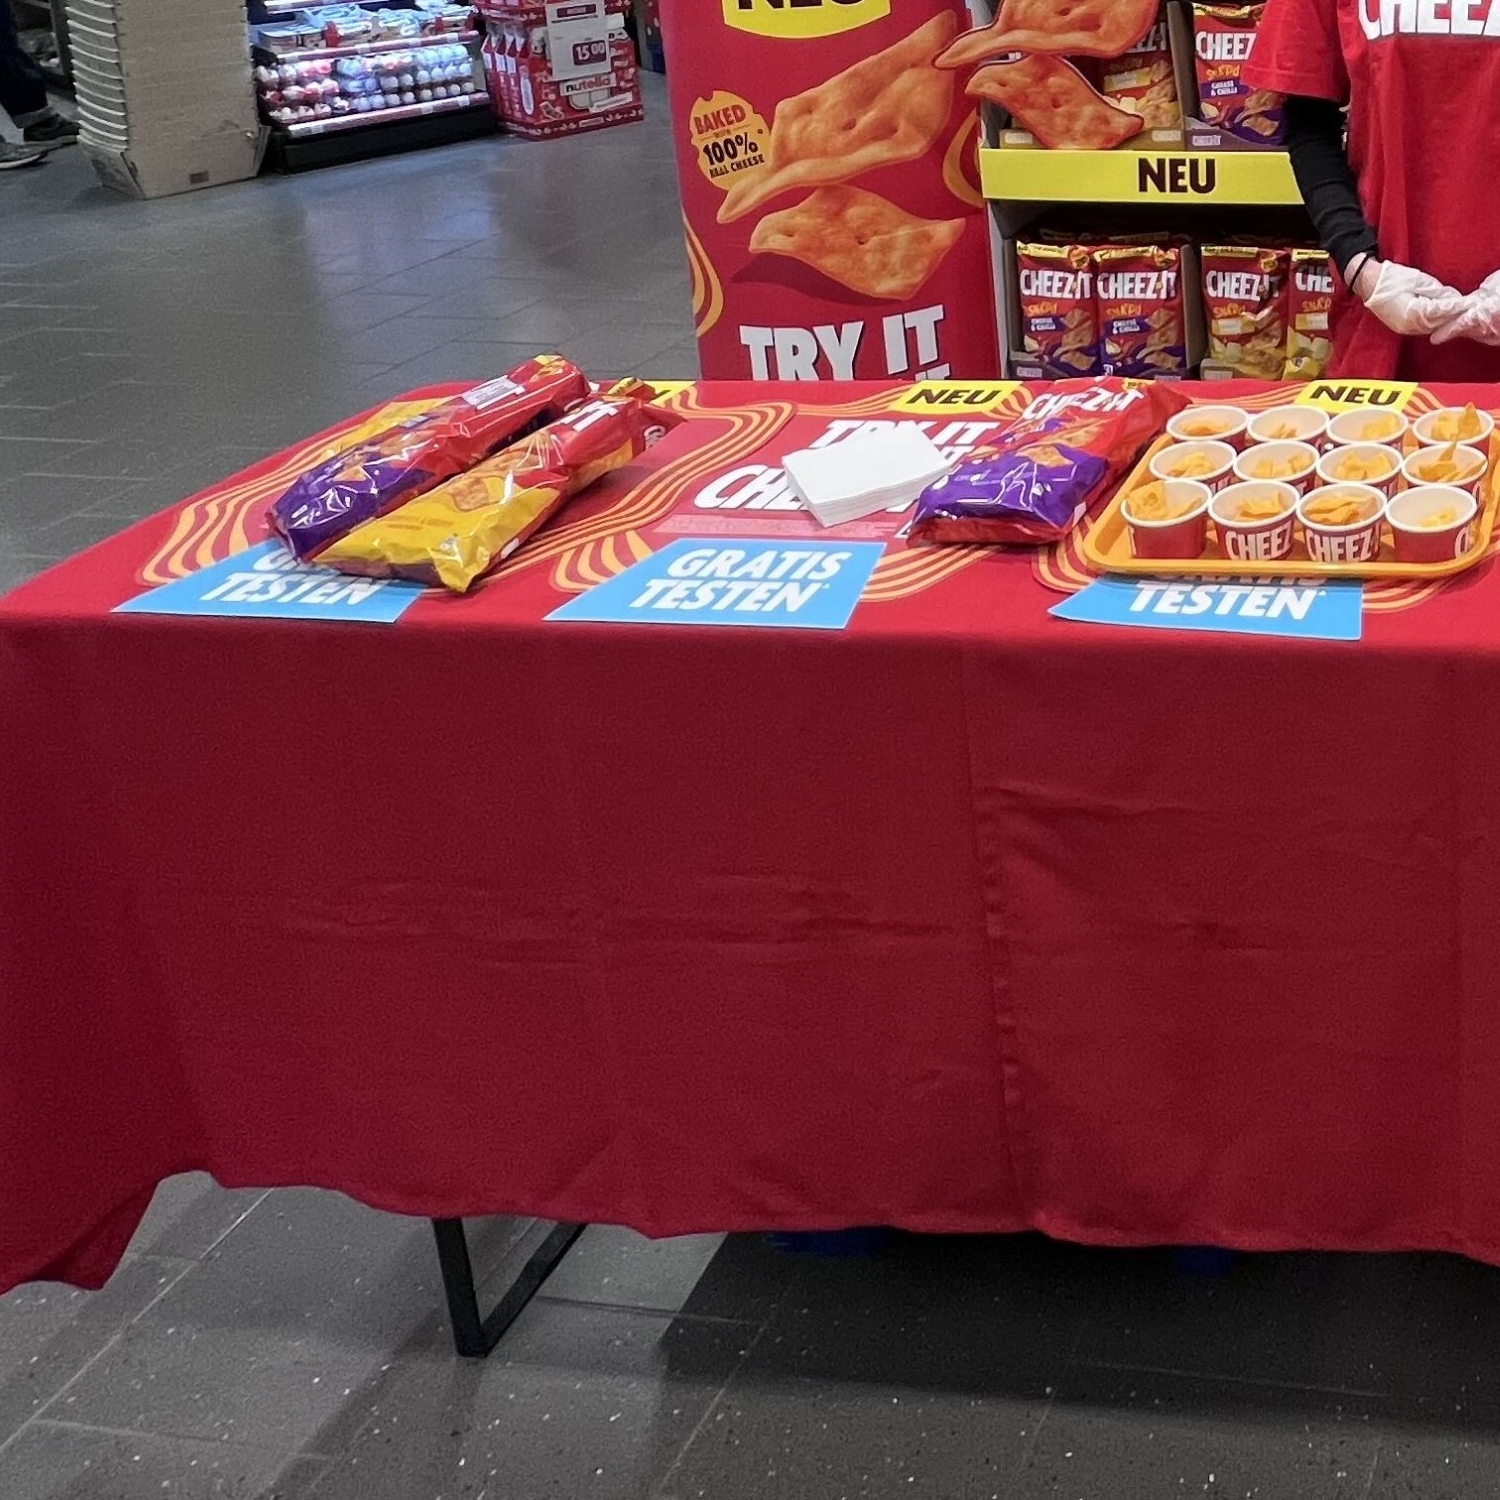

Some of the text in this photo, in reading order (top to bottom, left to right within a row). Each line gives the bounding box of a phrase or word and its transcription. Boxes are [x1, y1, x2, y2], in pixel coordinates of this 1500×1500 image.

[694, 104, 747, 135] BAKED
[702, 132, 759, 165] 100%
[731, 153, 765, 172] CHEESE
[1138, 157, 1217, 194] NEU
[739, 304, 944, 380] TRY IT
[906, 388, 1003, 405] NEU
[1308, 385, 1404, 406] NEU
[667, 547, 850, 581] GRATIS
[628, 578, 820, 613] TESTEN
[1129, 579, 1316, 620] TESTEN
